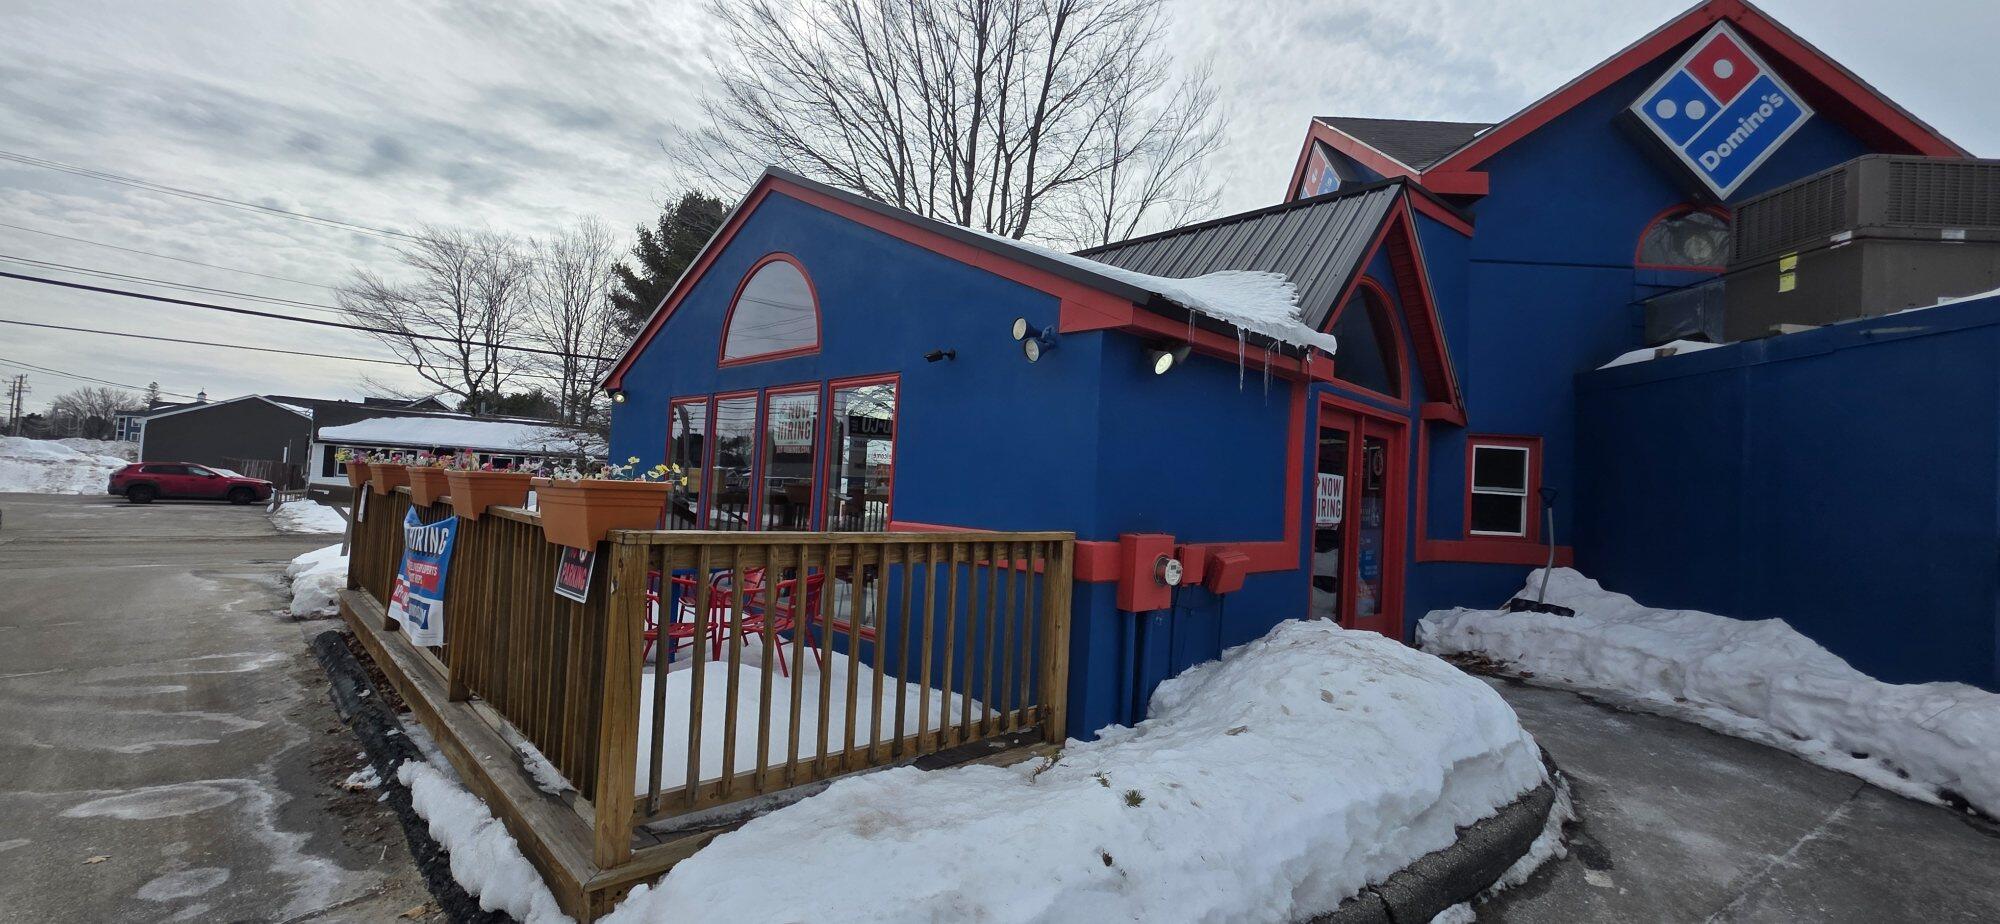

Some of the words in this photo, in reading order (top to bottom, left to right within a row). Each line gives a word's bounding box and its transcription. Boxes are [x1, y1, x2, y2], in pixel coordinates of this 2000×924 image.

[1698, 92, 1784, 172] Domino's
[788, 400, 811, 420] NOW
[777, 420, 811, 441] HIRING
[1321, 477, 1342, 498] NOW
[1317, 498, 1341, 519] IRING
[560, 562, 588, 591] PARKING
